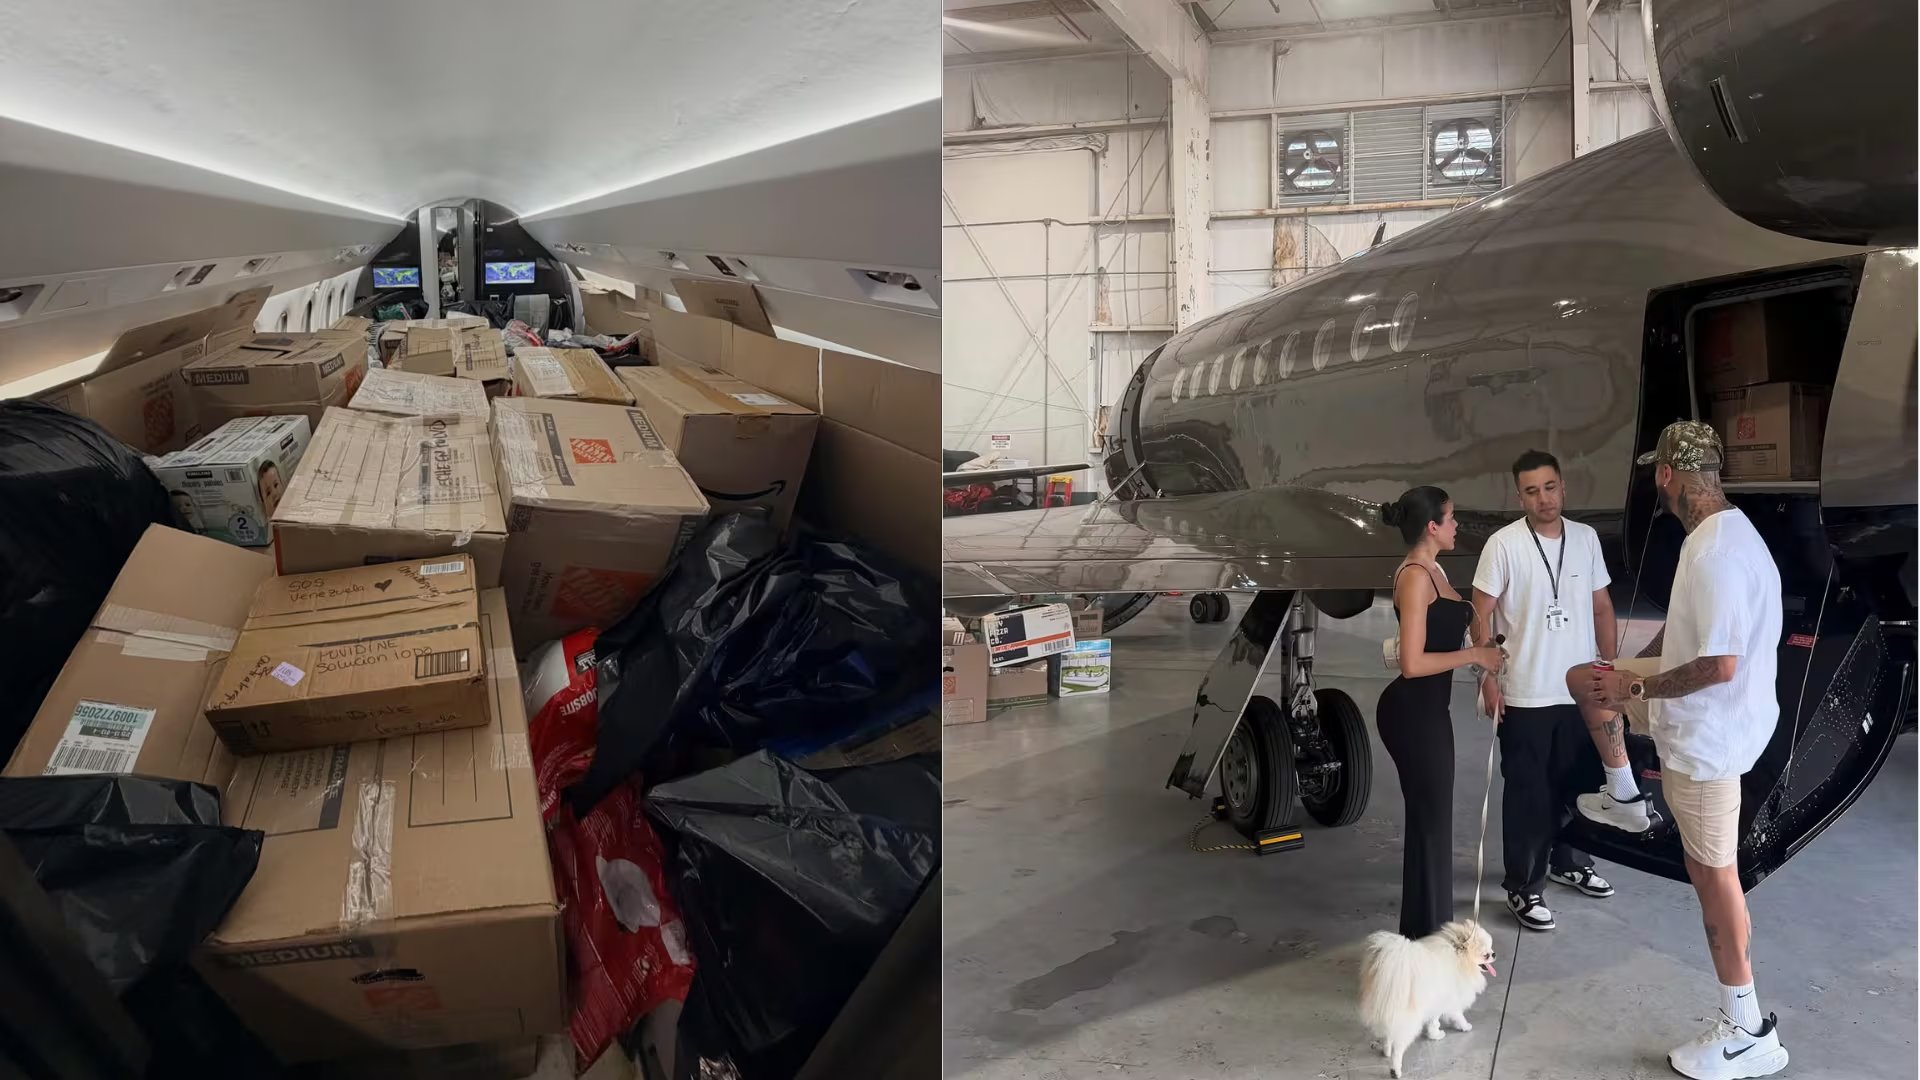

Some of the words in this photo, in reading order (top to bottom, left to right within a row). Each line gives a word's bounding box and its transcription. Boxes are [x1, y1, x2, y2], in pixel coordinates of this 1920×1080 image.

[321, 355, 344, 375] MEDIUM
[196, 372, 245, 384] MEDIUM
[629, 410, 660, 448] MEDIUM
[237, 517, 248, 529] 2
[288, 577, 325, 592] SOS
[560, 687, 598, 716] JOBSITE
[74, 704, 138, 723] 1009772056
[328, 748, 346, 800] FRAGILE
[229, 943, 362, 966] MEDIUM
